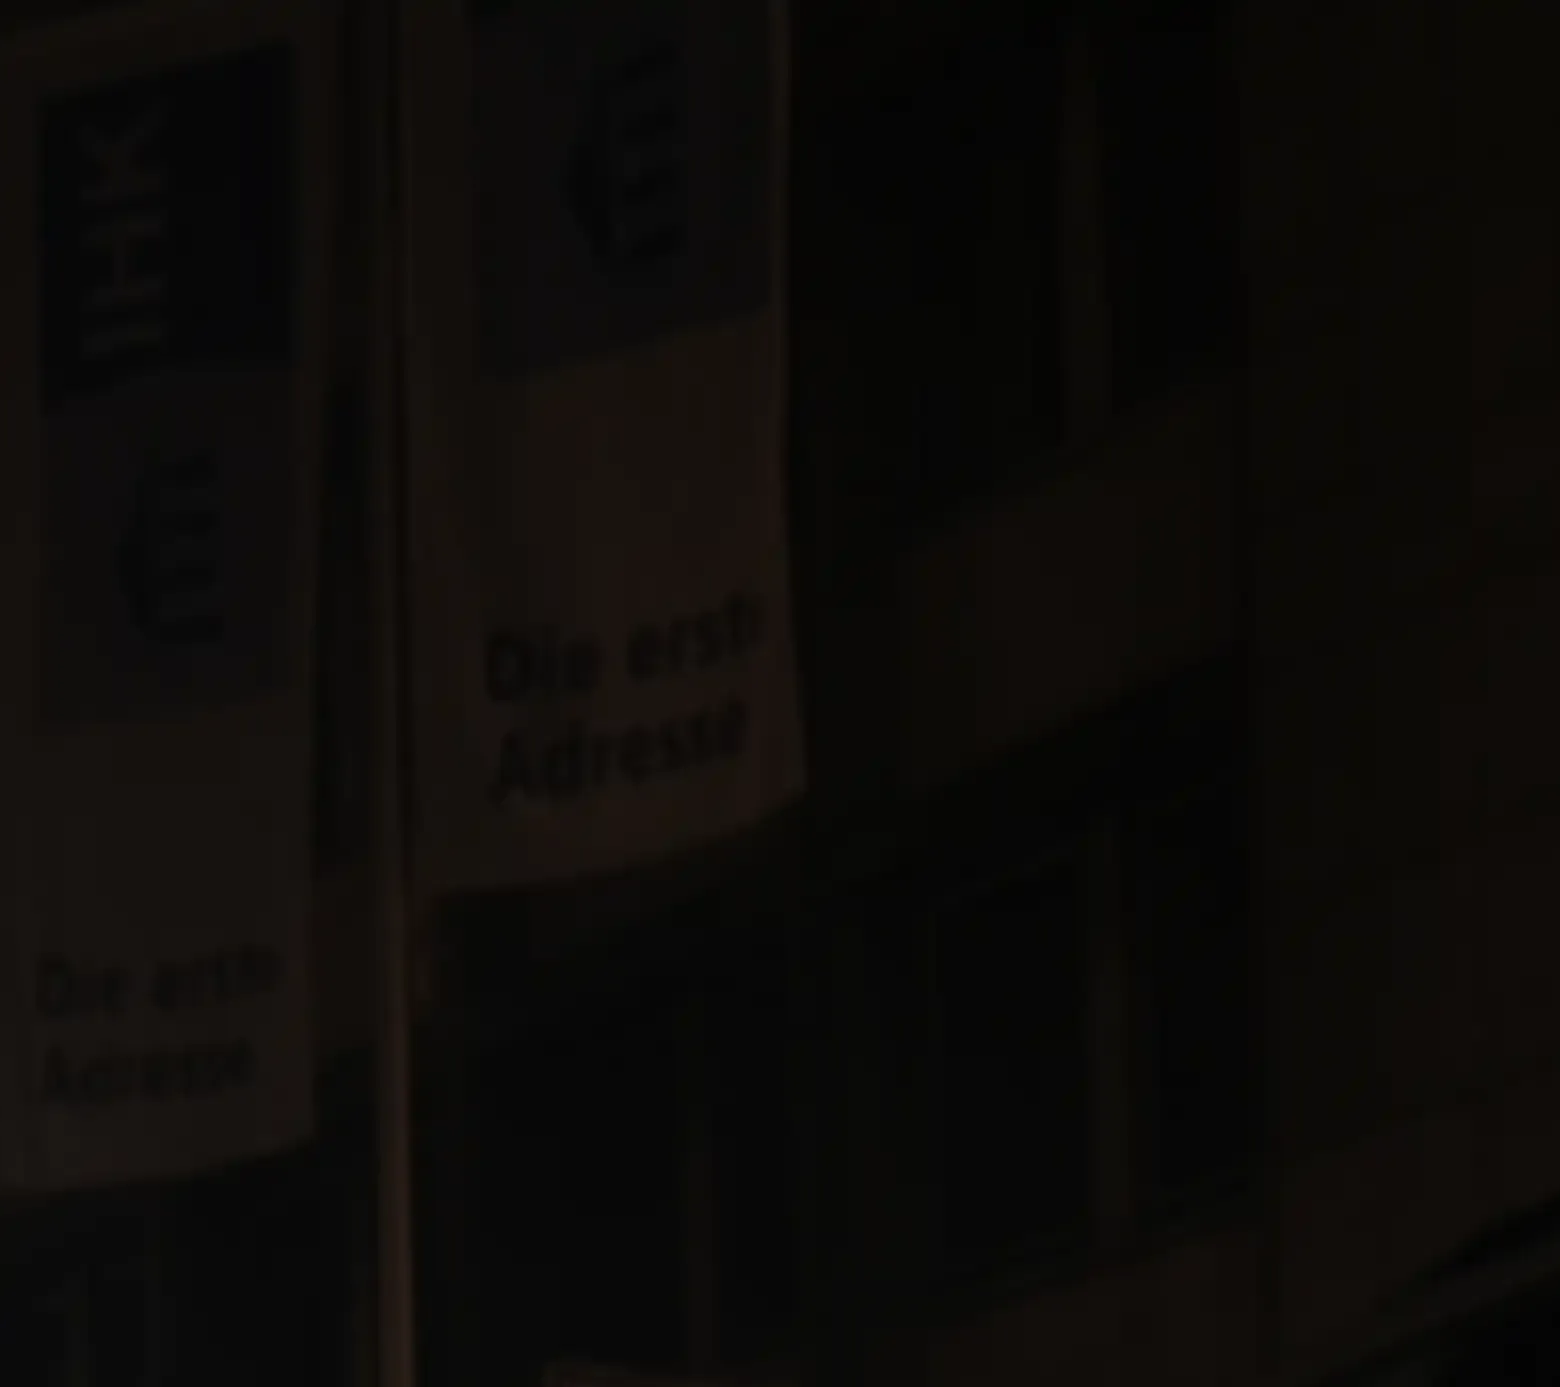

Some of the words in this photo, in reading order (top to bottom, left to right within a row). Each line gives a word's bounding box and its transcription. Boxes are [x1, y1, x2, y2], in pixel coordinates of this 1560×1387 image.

[78, 93, 172, 362] IHK
[484, 624, 600, 702] Die
[486, 692, 748, 808] Adresse
